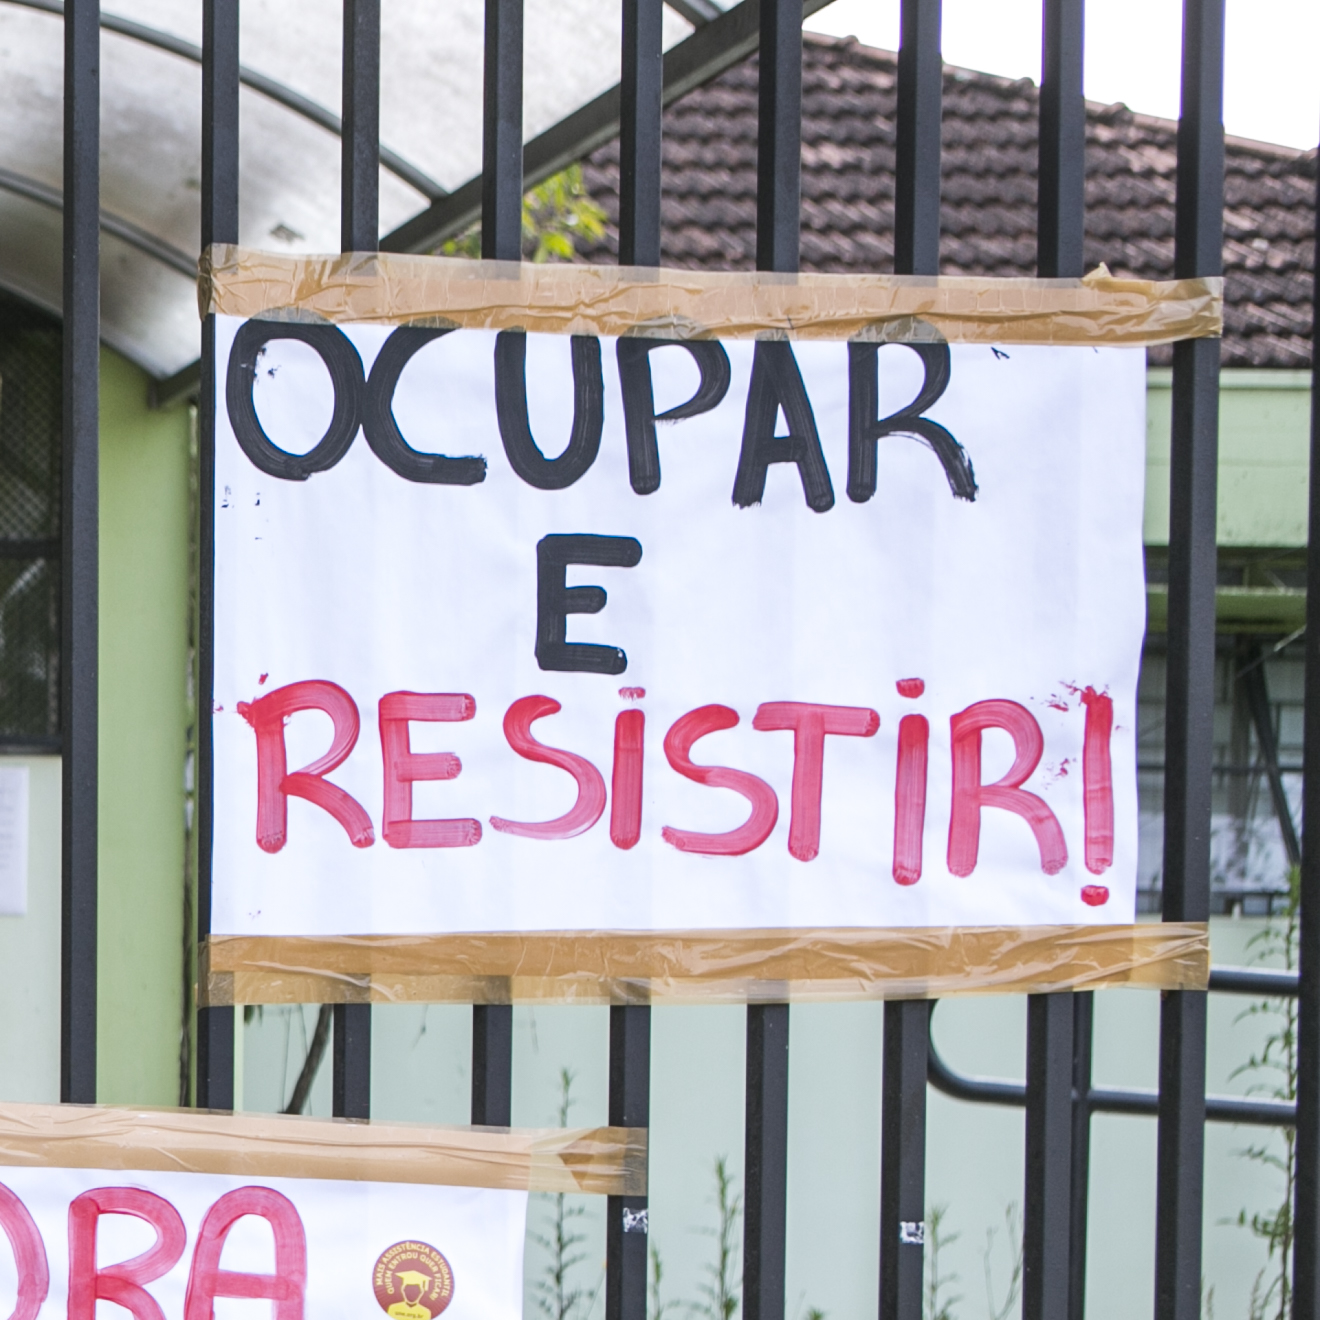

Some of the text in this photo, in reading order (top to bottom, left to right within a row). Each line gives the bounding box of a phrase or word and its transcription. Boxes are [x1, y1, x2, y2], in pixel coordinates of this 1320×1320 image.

[225, 306, 979, 513] OCUPAR
[535, 533, 643, 674] E
[375, 1241, 451, 1297] MAIS ASSISTÊNCIA ESTUDANTIL
[387, 1252, 419, 1270] ENTROU
[419, 1254, 439, 1273] QUER
[384, 1270, 395, 1295] QUEM
